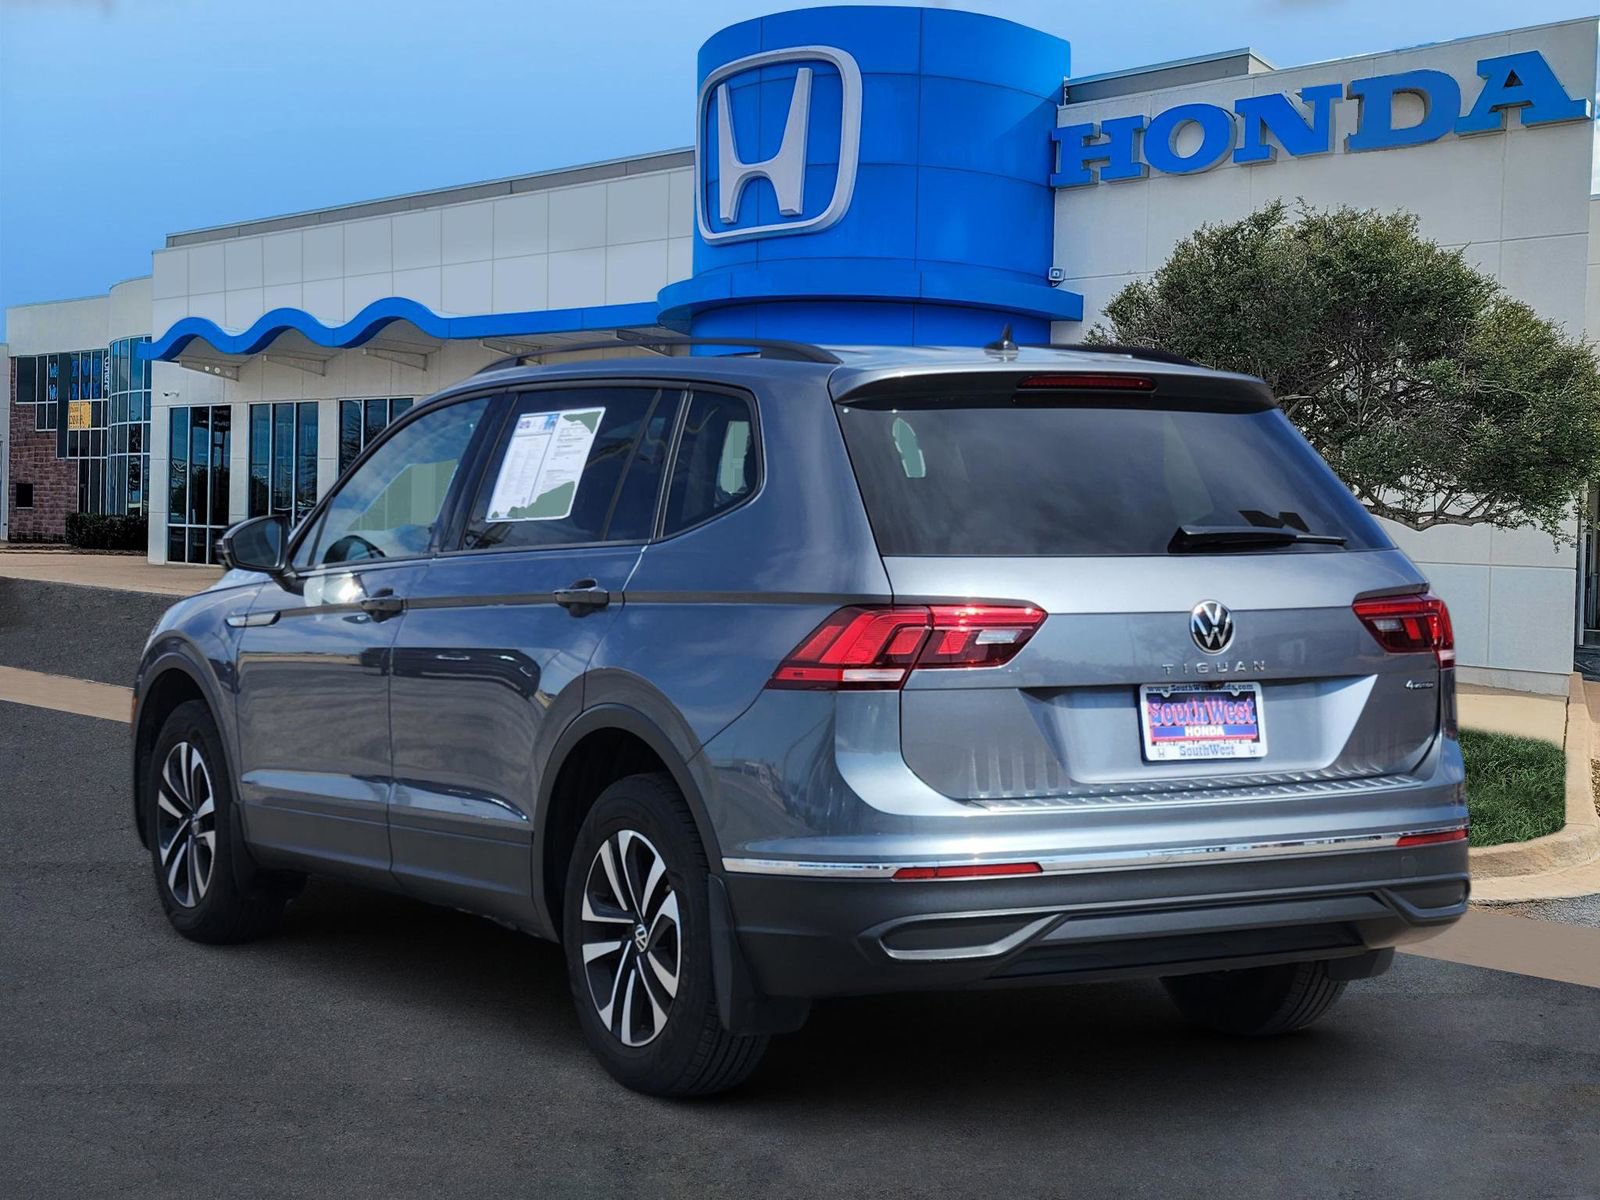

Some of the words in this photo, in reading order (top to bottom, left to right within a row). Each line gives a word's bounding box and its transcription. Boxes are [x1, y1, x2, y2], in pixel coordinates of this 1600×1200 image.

[1050, 50, 1592, 189] HONDA
[1162, 660, 1266, 675] TIGUAN
[1148, 696, 1256, 727] SouthWest
[1184, 726, 1225, 737] HONDA
[1179, 743, 1236, 757] SouthWest
